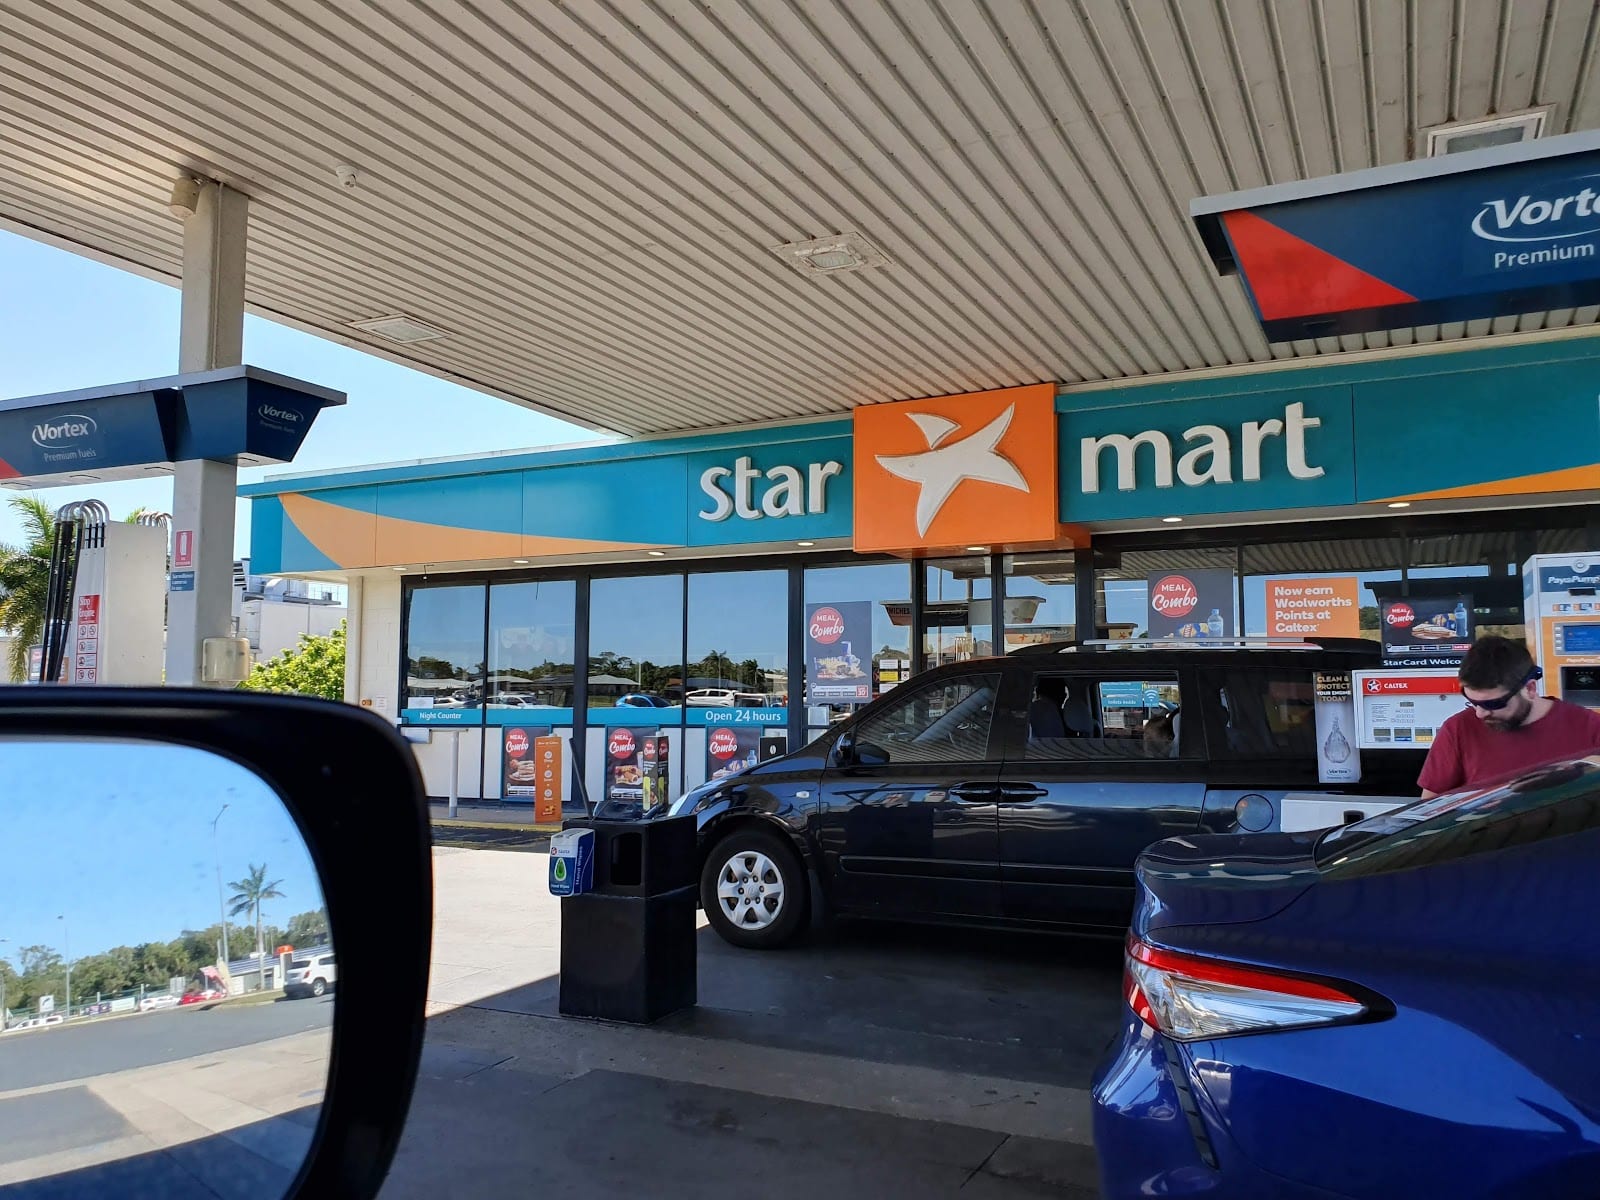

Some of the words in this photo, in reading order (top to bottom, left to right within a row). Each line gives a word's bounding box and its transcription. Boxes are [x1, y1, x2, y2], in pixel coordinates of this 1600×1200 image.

[1481, 188, 1600, 229] Vort
[1494, 243, 1595, 269] Premium
[263, 404, 298, 422] Vortex
[34, 422, 89, 441] Vortex
[1080, 401, 1326, 495] mart
[43, 451, 77, 463] Premium
[698, 456, 844, 523] star
[1161, 583, 1187, 592] MEAL
[1274, 586, 1302, 596] Now
[1305, 587, 1333, 595] earn
[1151, 587, 1198, 612] Combo
[1274, 597, 1352, 608] Woolworths
[816, 614, 836, 622] MEAL
[1275, 610, 1314, 620] Points
[1316, 610, 1331, 619] at
[1386, 609, 1415, 625] Combo
[809, 617, 845, 639] Combo
[1275, 622, 1318, 632] Caltex
[1383, 659, 1427, 667] StarCard
[1317, 675, 1342, 683] CLEAN
[419, 712, 437, 721] Night
[437, 711, 462, 719] Counter
[705, 710, 732, 723] Open
[735, 709, 750, 722] 24
[752, 710, 781, 720] hours
[505, 736, 529, 753] Combo
[609, 737, 636, 754] Combo
[709, 737, 738, 755] Combo
